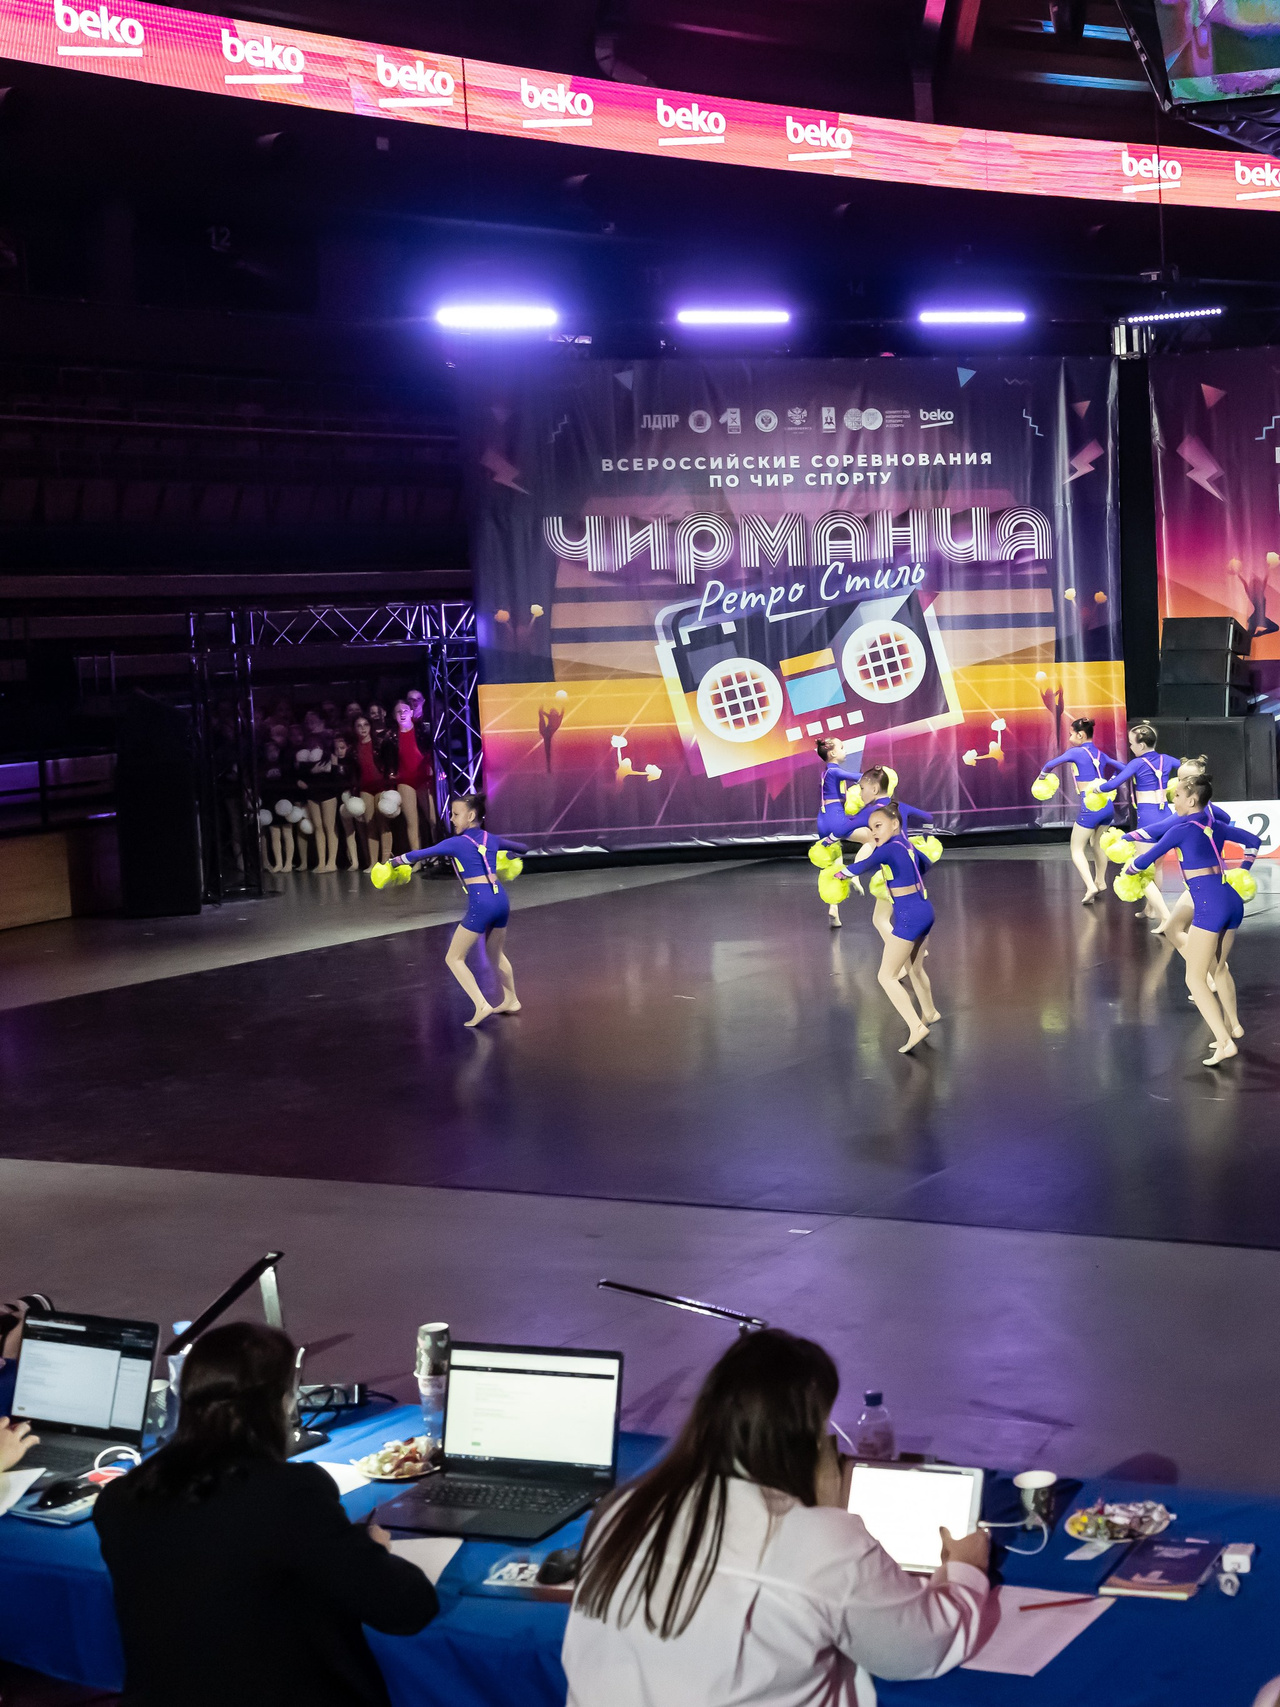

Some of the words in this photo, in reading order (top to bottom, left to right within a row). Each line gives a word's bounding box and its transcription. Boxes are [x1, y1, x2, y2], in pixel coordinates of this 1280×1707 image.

[54, 0, 145, 45] beko
[221, 29, 304, 73] beko
[376, 54, 455, 96] beko
[520, 78, 594, 116] beko
[657, 98, 726, 134] beko
[786, 116, 853, 149] beko
[1122, 151, 1182, 179] beko
[641, 414, 680, 430] ЛДПР
[920, 408, 954, 421] beko
[601, 454, 801, 472] ВСЕРОССИЙСКИЕ
[811, 452, 992, 468] СОРЕВНОВАНИЯ
[709, 474, 740, 488] ПО
[750, 473, 795, 487] ЧИР
[805, 471, 892, 486] СПОРТУ
[698, 579, 806, 622] Ретро
[819, 561, 926, 602] Стиль
[1247, 813, 1272, 846] 2
